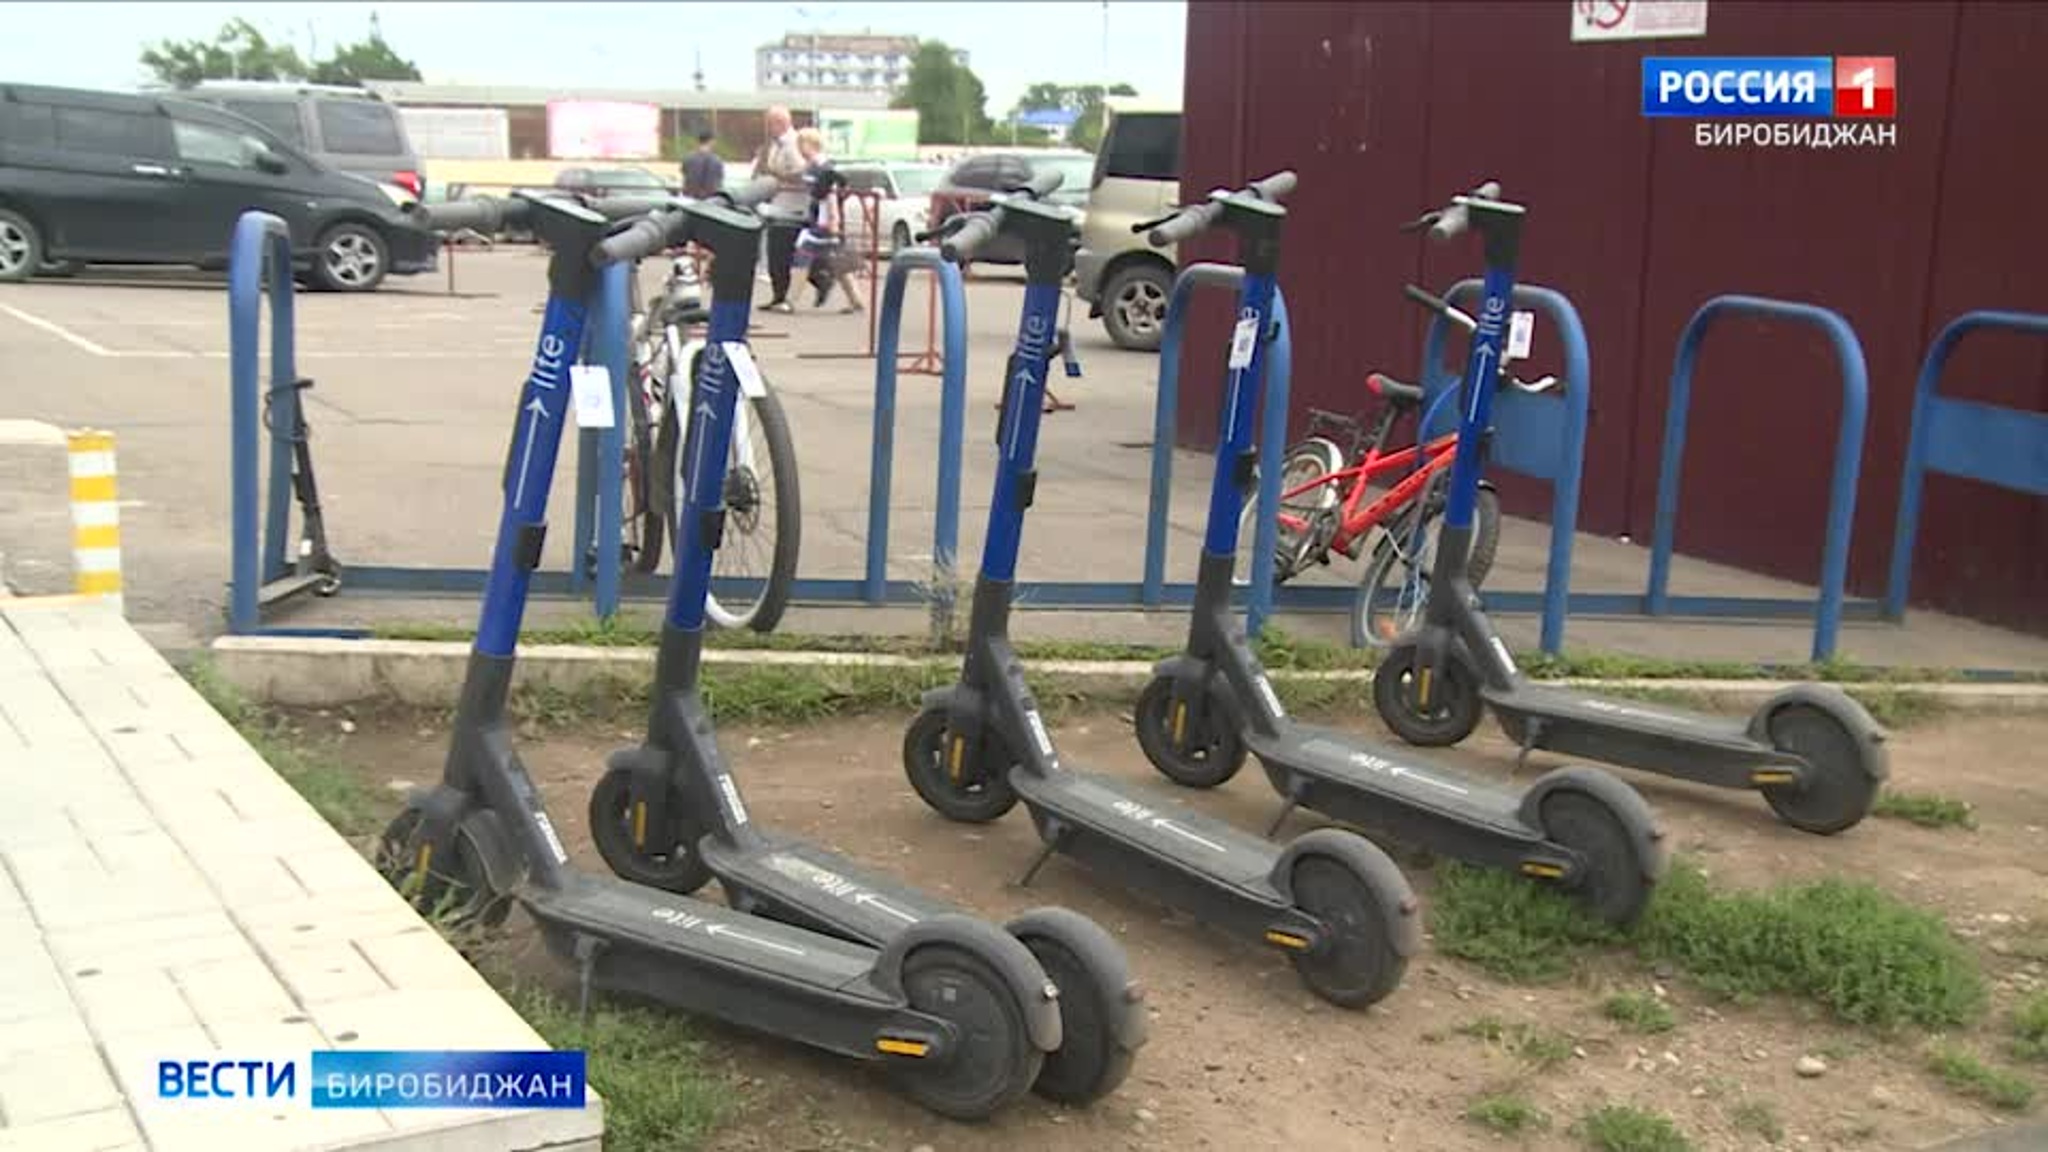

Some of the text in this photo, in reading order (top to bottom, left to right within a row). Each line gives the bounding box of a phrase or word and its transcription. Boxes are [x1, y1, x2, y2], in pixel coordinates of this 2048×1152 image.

[1017, 315, 1047, 360] lite
[1478, 297, 1505, 336] lite
[531, 334, 565, 390] lite
[699, 343, 726, 394] lite
